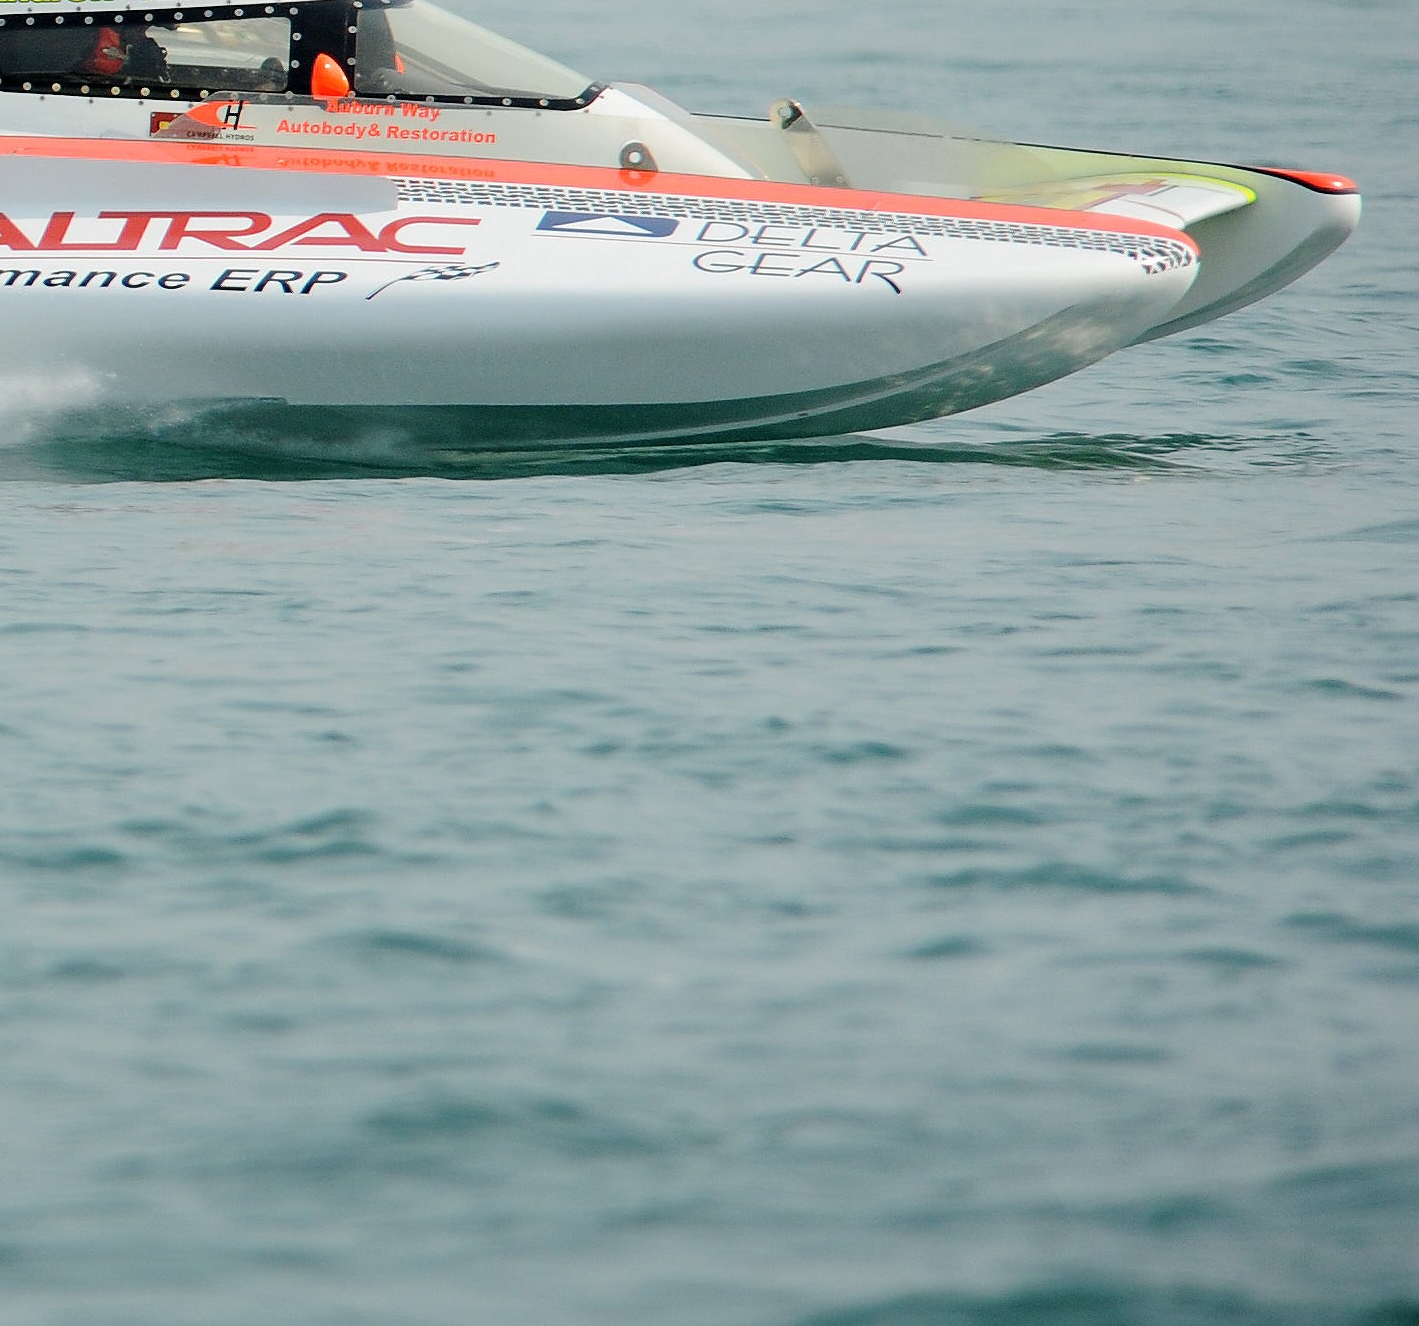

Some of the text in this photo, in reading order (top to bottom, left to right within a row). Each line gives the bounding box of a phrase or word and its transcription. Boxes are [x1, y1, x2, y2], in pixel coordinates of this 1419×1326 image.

[325, 99, 441, 121] Auburn Way
[386, 125, 496, 144] Restoration
[696, 221, 927, 256] DELTA
[210, 269, 349, 294] ERP
[692, 250, 905, 294] GEAR
